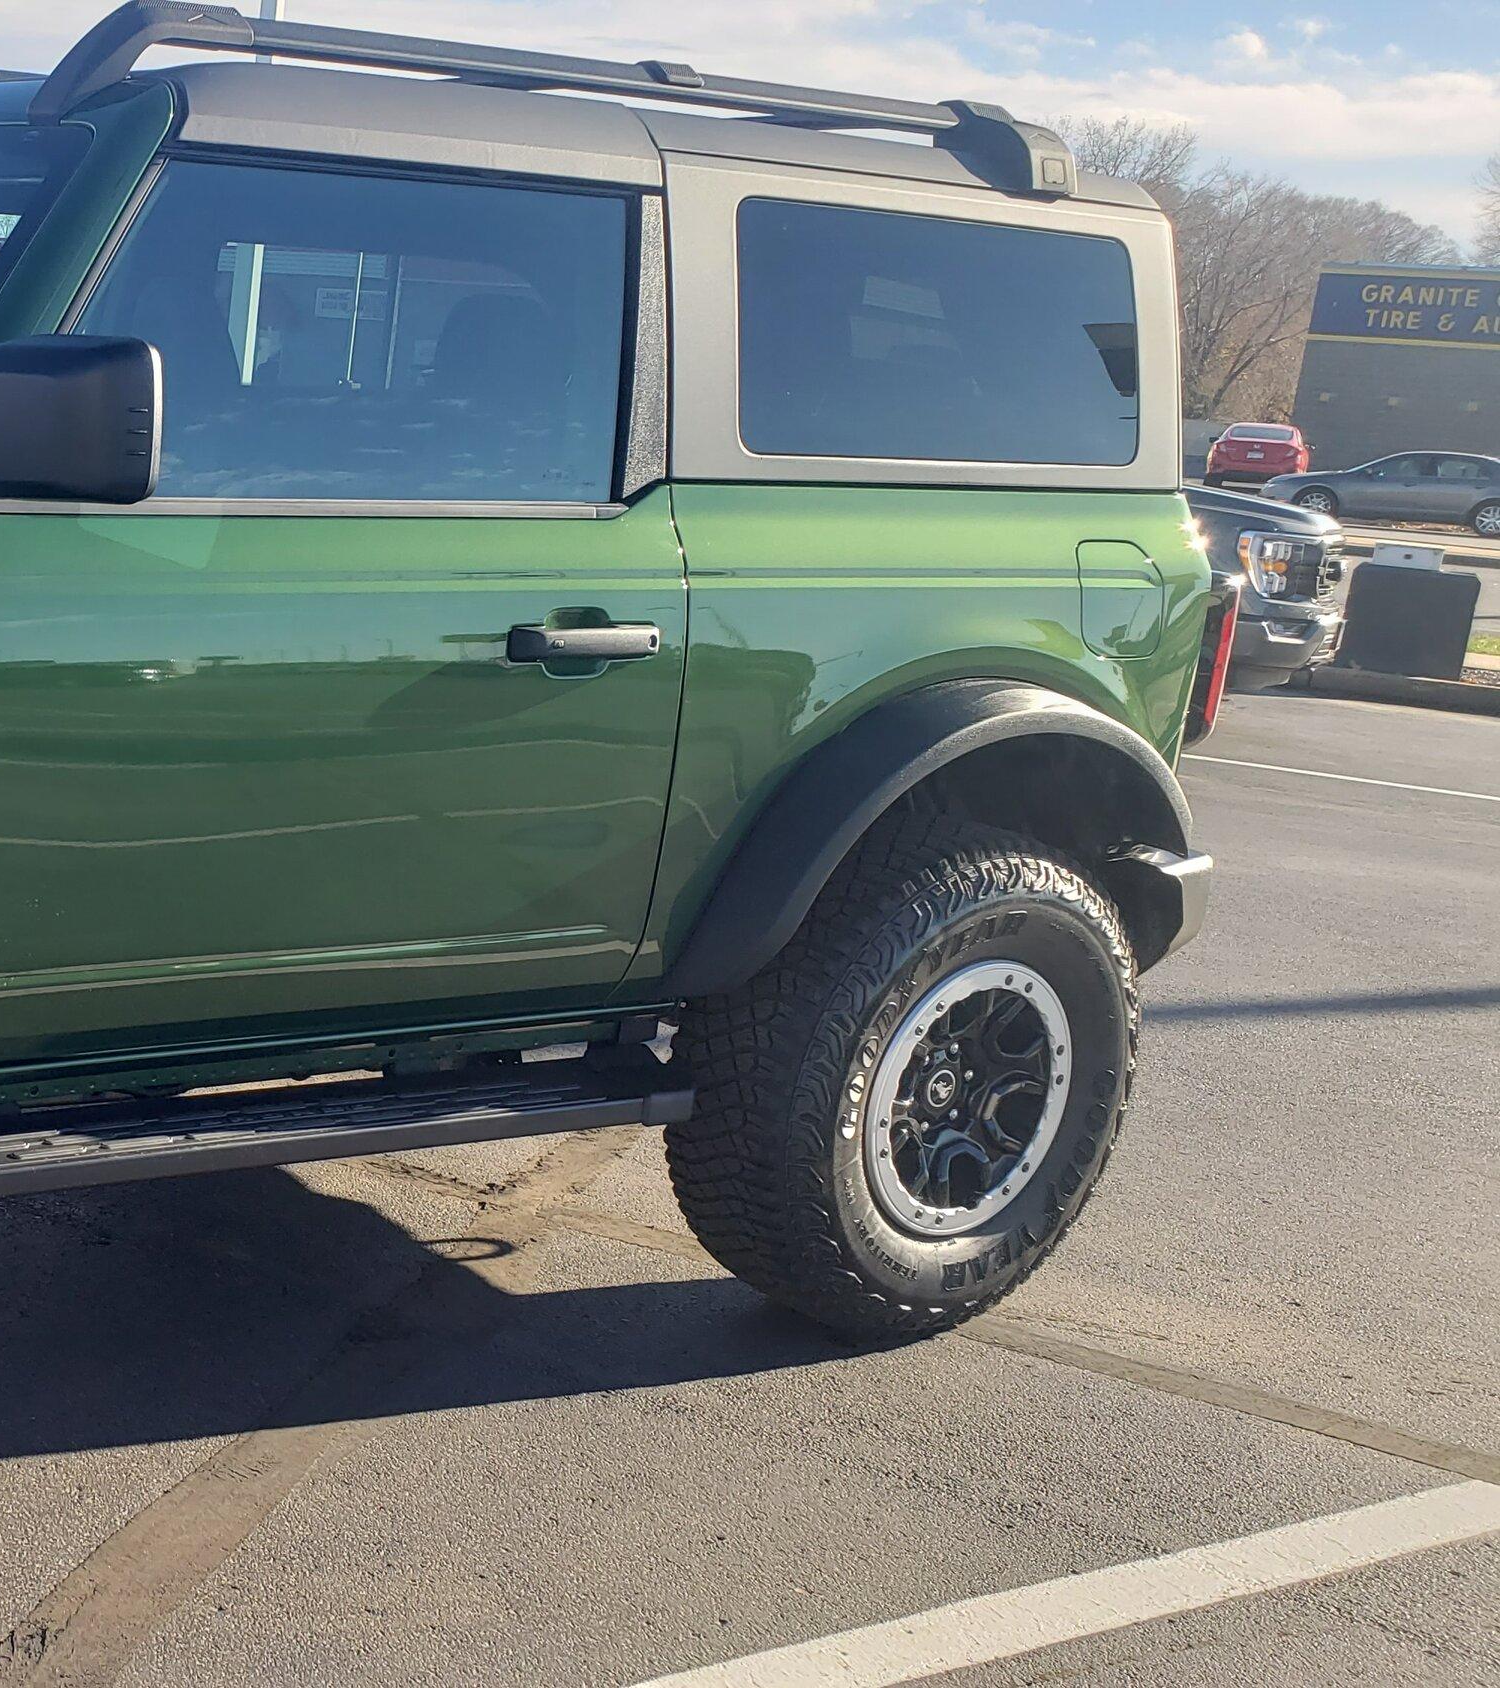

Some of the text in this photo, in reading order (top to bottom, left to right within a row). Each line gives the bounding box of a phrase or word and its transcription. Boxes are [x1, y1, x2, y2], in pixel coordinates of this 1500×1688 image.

[1361, 284, 1480, 308] GRANITE
[1365, 309, 1422, 330] TIRE
[1437, 313, 1456, 332] &
